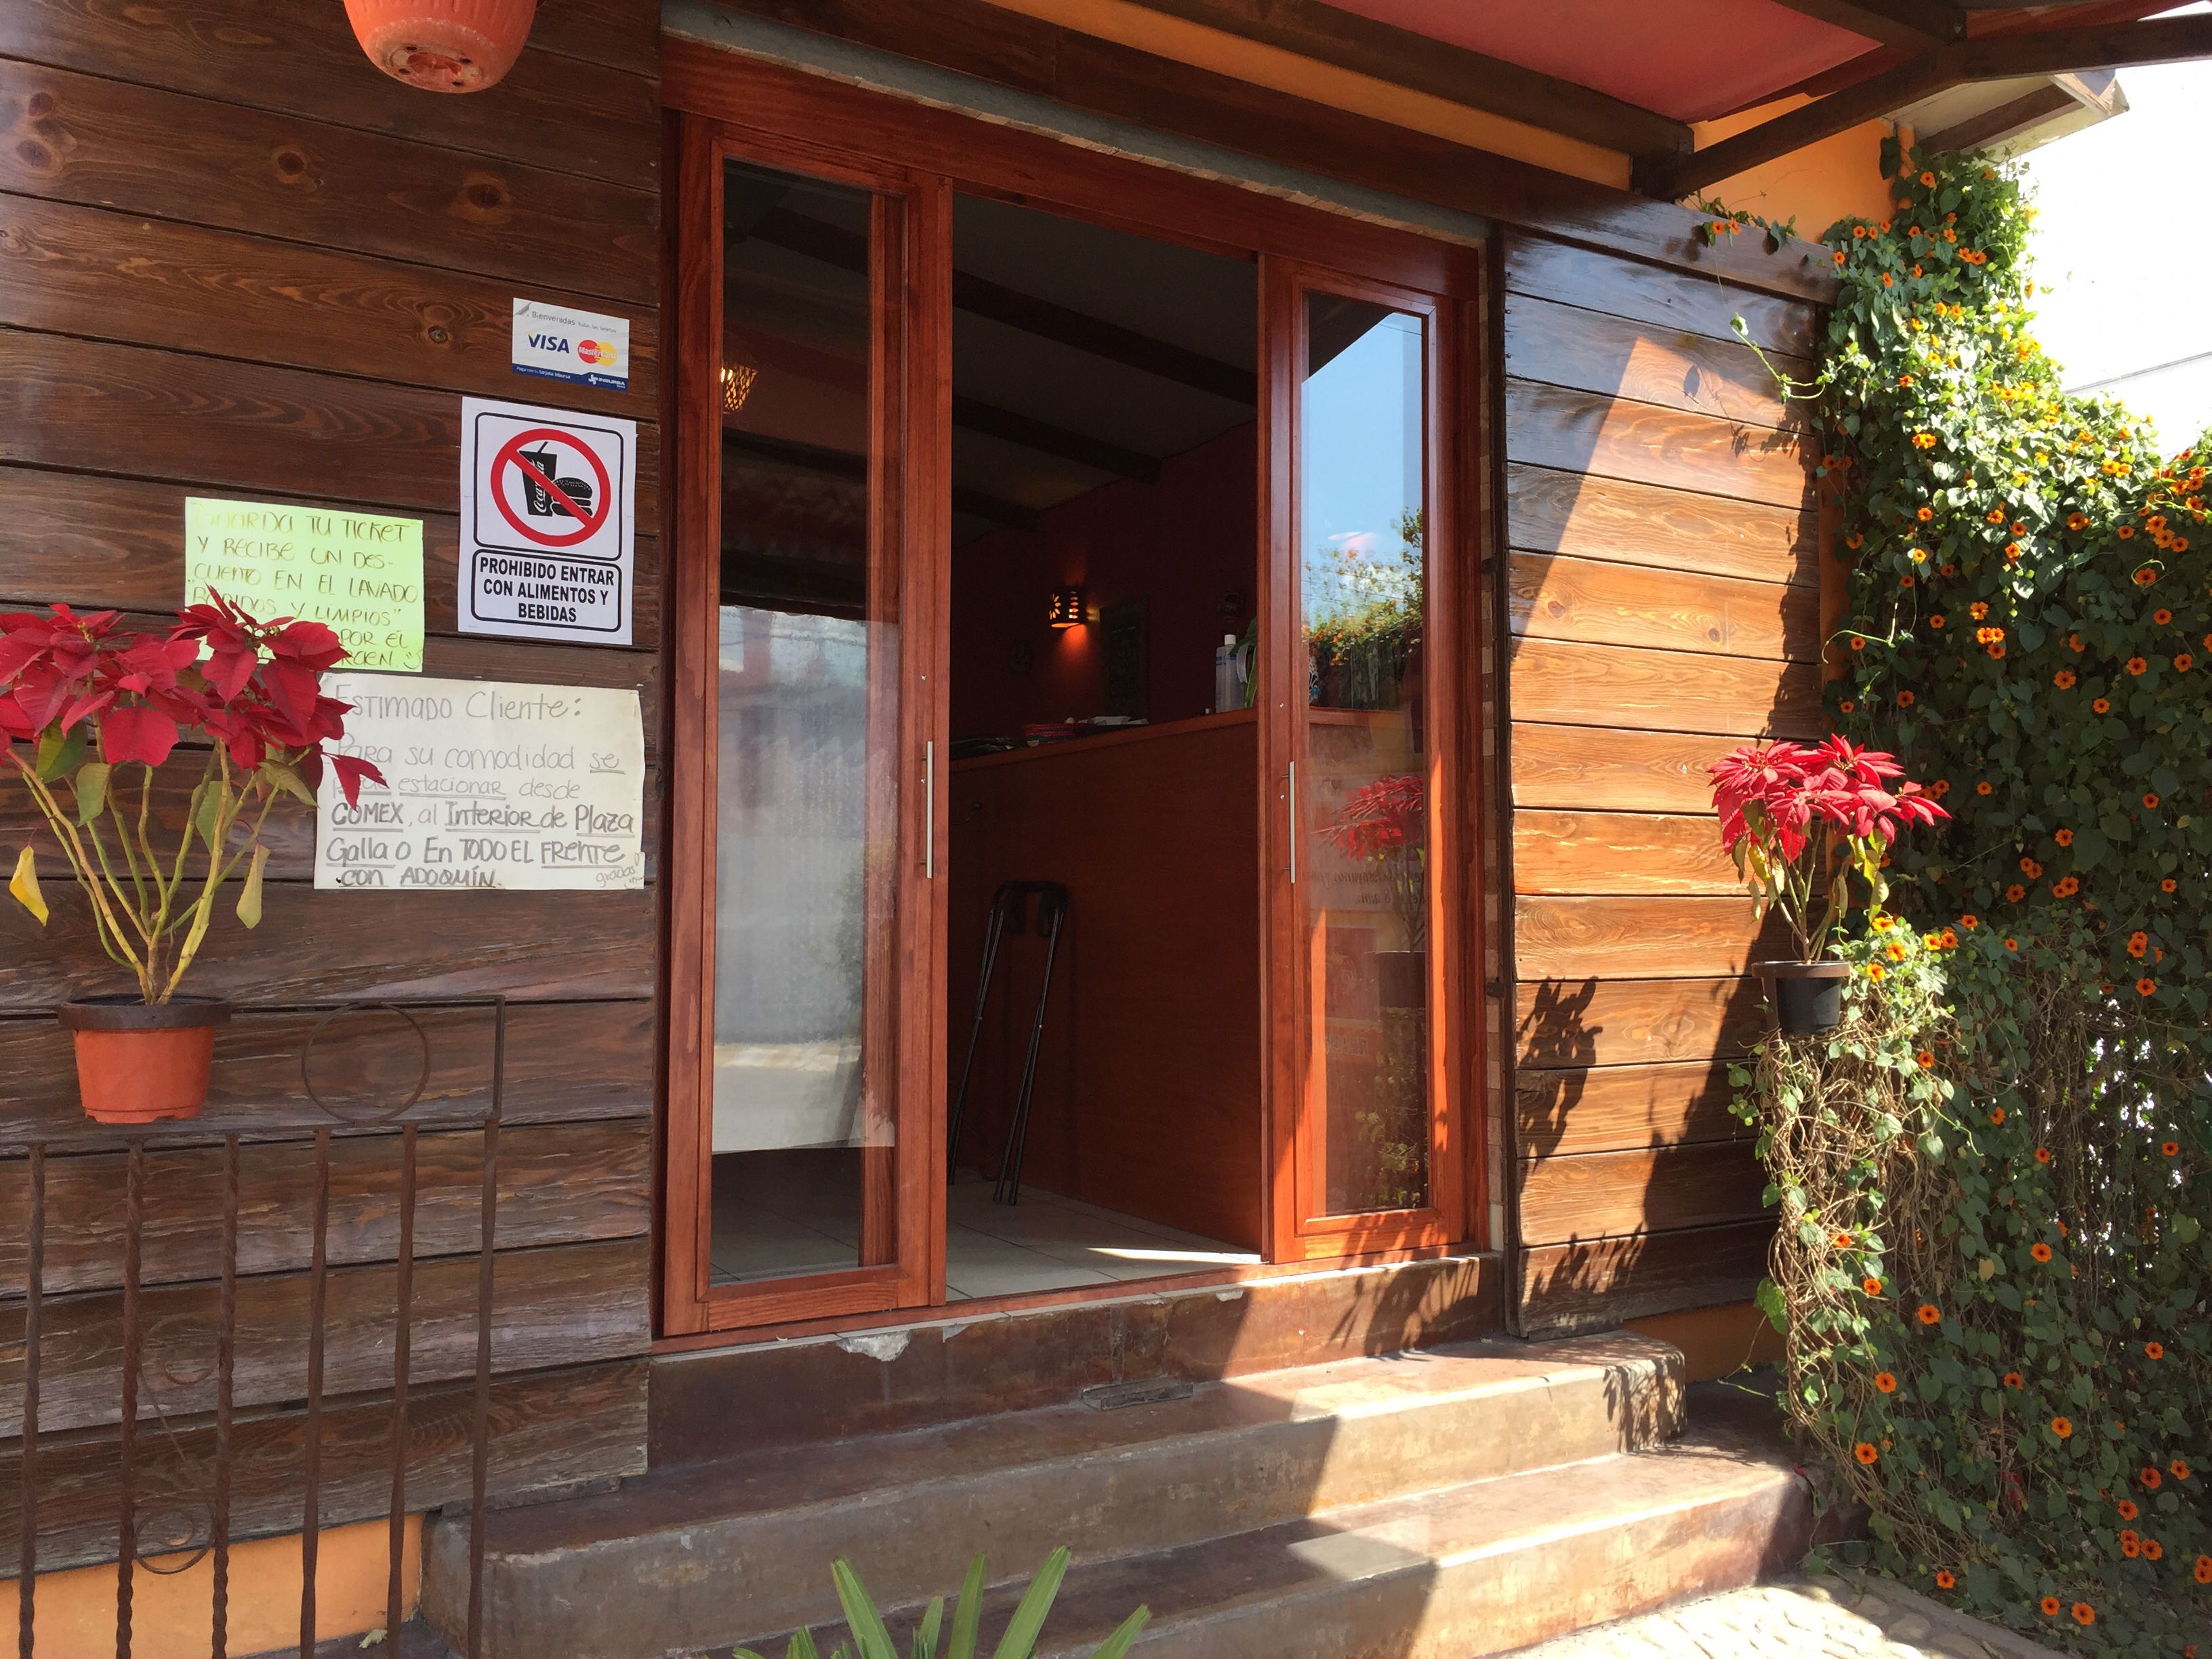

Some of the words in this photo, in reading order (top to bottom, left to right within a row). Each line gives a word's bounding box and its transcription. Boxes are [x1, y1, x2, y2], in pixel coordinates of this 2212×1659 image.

[531, 311, 575, 326] Bienvenidas
[528, 333, 570, 354] VISA
[306, 516, 331, 535] TU
[311, 548, 342, 564] UN
[480, 556, 556, 580] PROHIBIDO
[561, 565, 614, 586] ENTRAR
[274, 570, 302, 590] EN
[319, 574, 335, 595] EL
[349, 577, 418, 602] LAVADO
[483, 578, 513, 596] CON
[518, 581, 596, 605] ALIMENTOS
[600, 590, 609, 605] Y
[518, 602, 577, 623] BEBIDAS
[340, 628, 378, 647] POR
[466, 691, 581, 720] Cliente:
[405, 747, 433, 766] su
[445, 745, 575, 770] comodidad
[590, 752, 619, 770] se
[519, 778, 580, 800] desde
[417, 804, 436, 825] al
[540, 805, 567, 828] de
[575, 804, 634, 834] Plaza
[326, 837, 388, 867] Galla
[424, 836, 452, 863] En
[459, 838, 507, 862] TODO
[511, 840, 534, 863] EL
